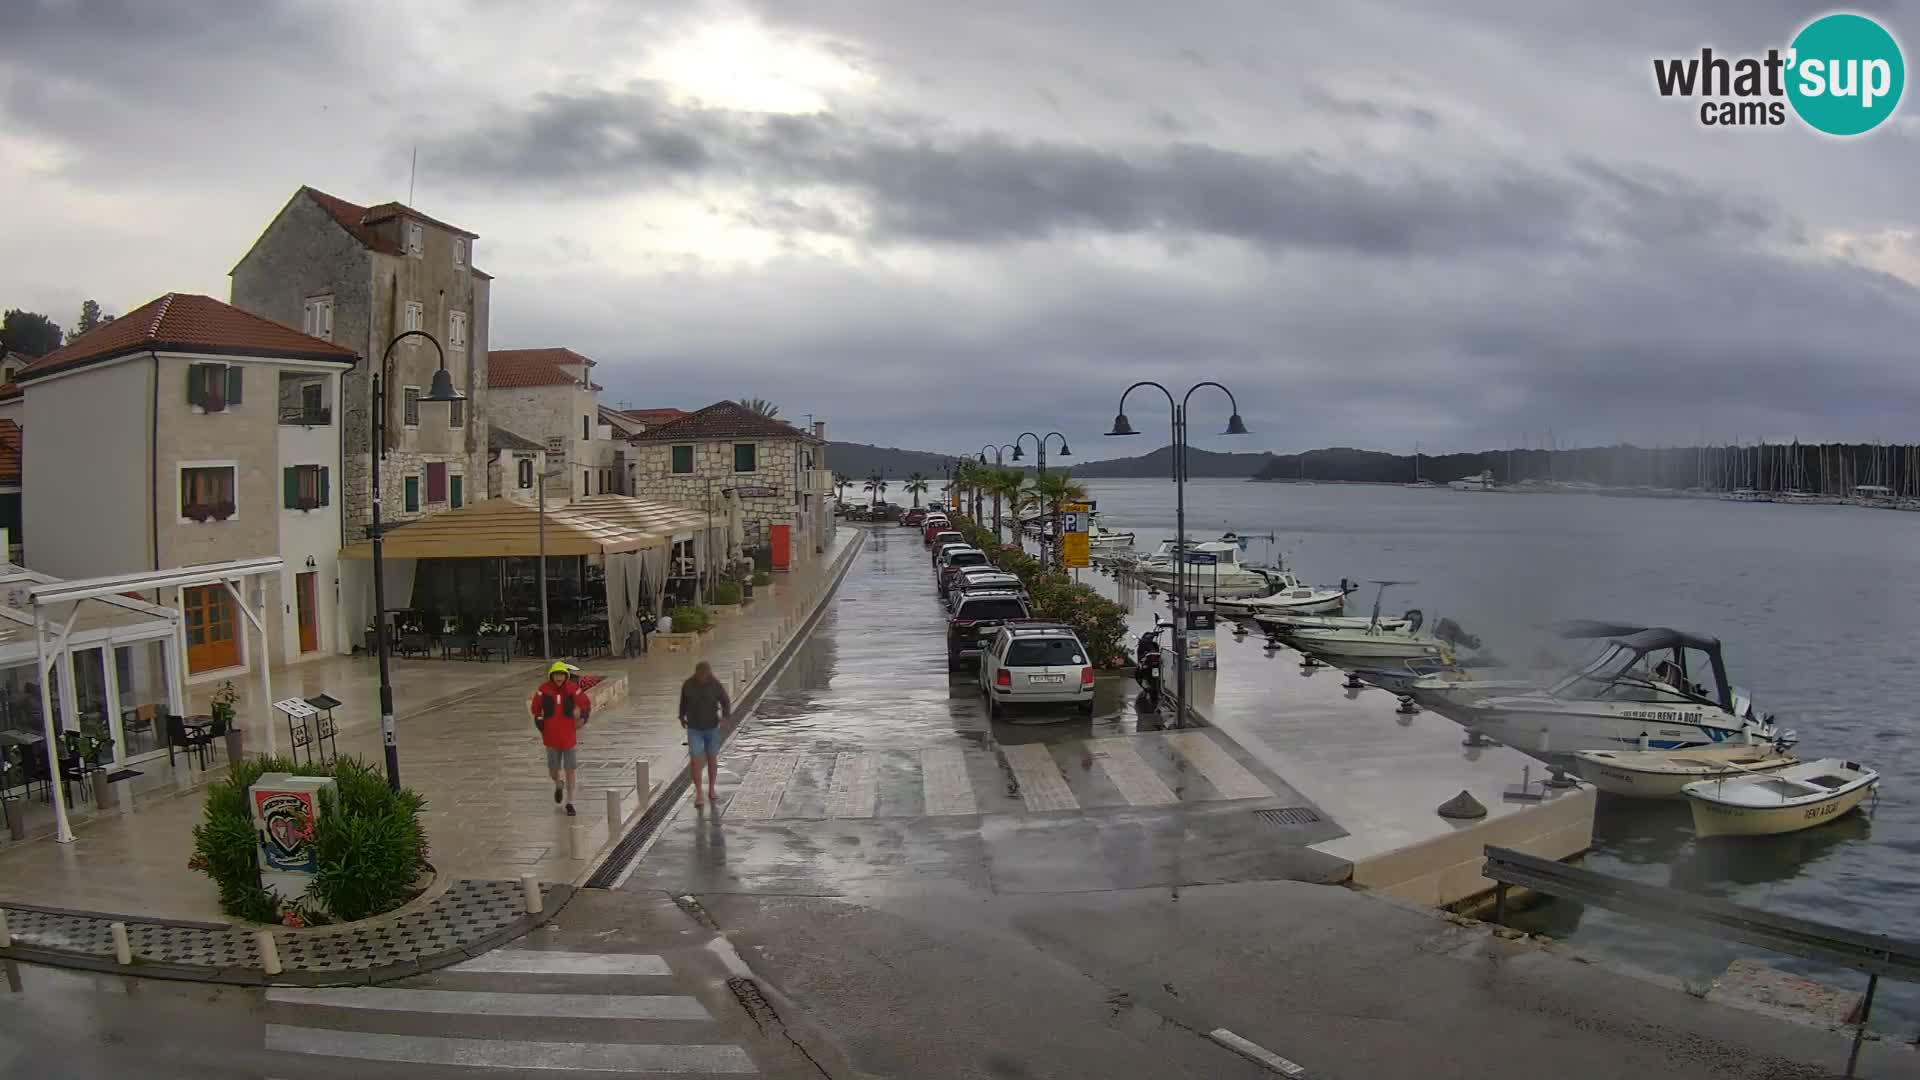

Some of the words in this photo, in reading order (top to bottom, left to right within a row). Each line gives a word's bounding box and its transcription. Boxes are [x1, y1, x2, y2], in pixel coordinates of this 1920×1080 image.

[1065, 515, 1075, 531] P
[1657, 712, 1676, 720] RENT
[1684, 712, 1703, 723] BOAT
